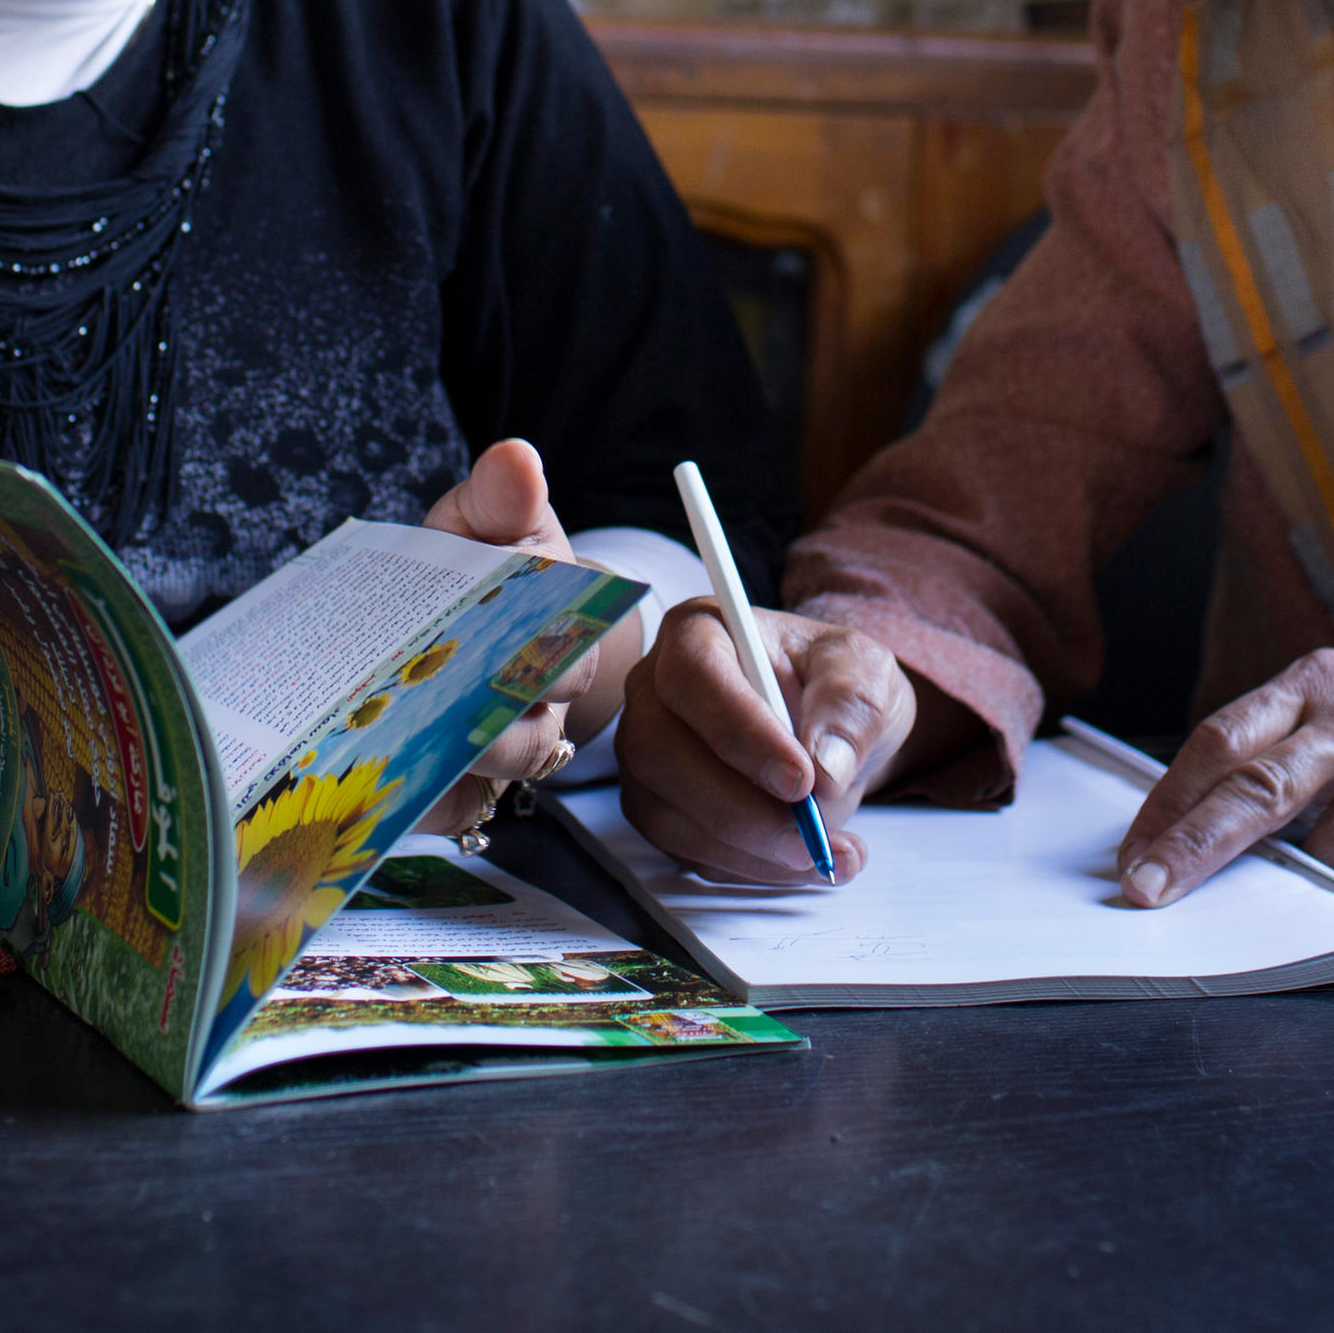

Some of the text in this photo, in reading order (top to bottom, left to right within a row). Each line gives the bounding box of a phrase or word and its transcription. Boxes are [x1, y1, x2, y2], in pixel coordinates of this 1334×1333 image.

[309, 705, 341, 738] سماد
[105, 805, 119, 875] سماد
[158, 943, 186, 1036] سماد
